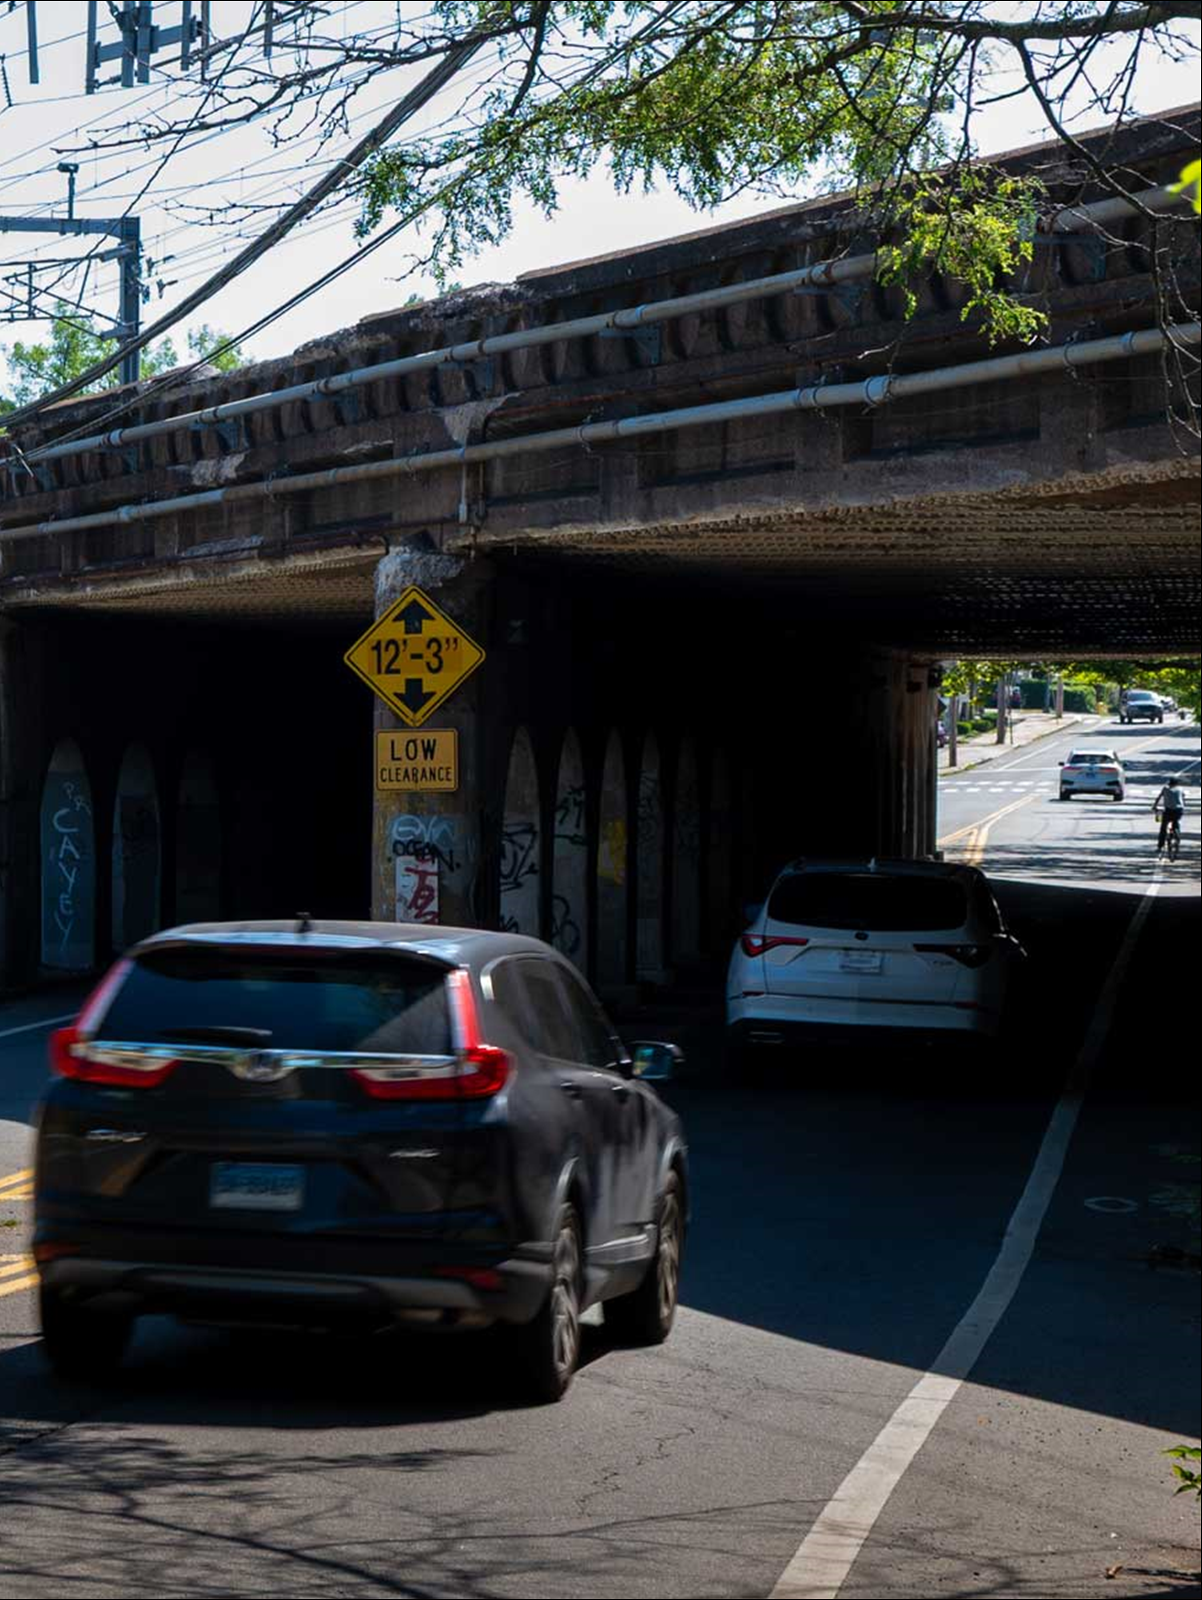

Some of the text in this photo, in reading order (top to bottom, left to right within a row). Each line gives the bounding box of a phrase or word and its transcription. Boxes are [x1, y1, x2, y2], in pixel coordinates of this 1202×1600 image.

[390, 739, 436, 761] LOW
[380, 767, 453, 783] CLEARANCE
[52, 808, 81, 951] CAYEY
